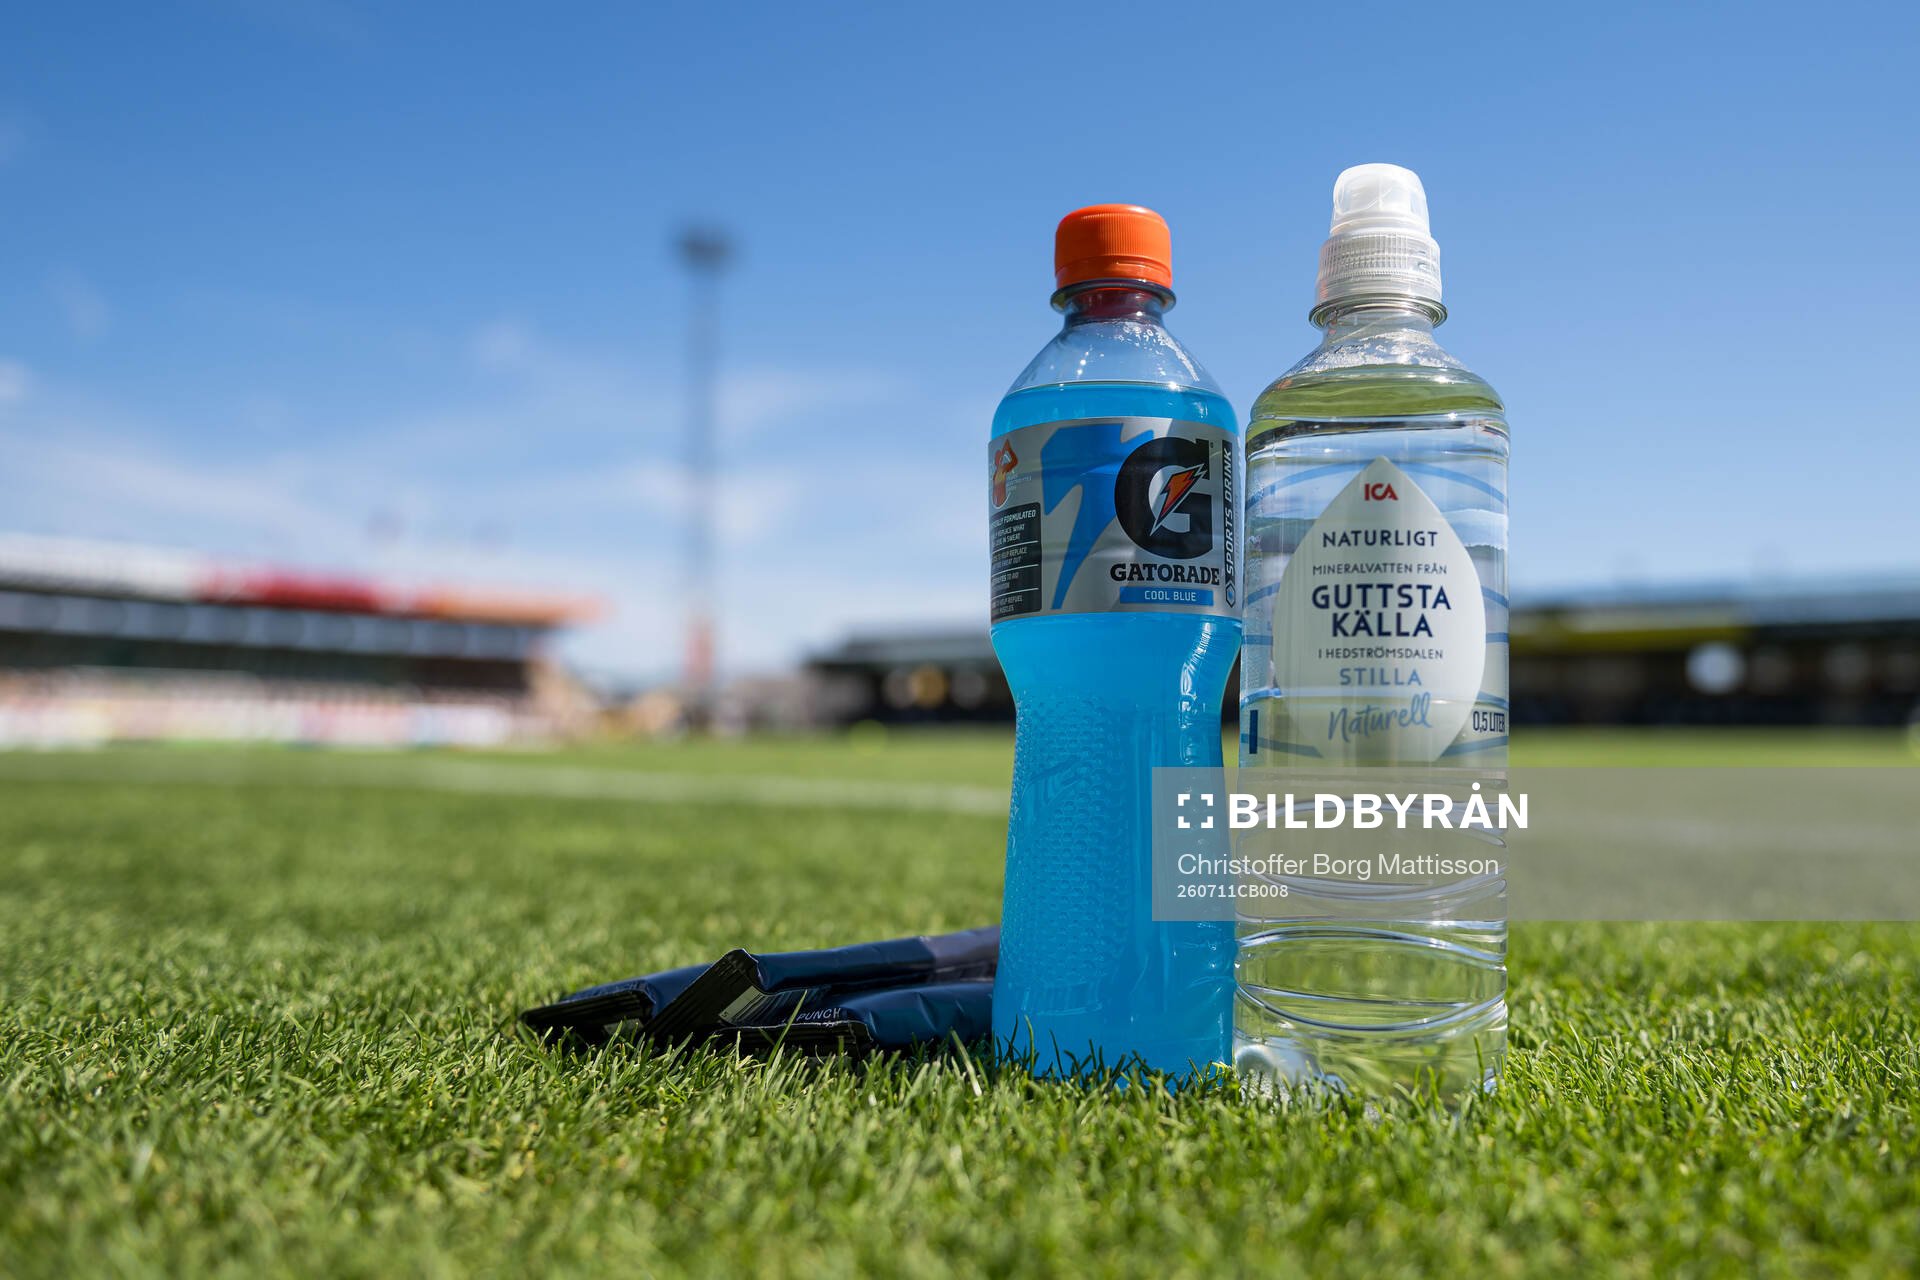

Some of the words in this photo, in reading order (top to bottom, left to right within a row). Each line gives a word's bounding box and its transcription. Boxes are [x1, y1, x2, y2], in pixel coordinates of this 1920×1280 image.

[1223, 447, 1232, 503] DRINK
[1364, 483, 1398, 501] ICA
[1004, 509, 1037, 523] FORMULATED
[1225, 507, 1233, 577] SPORTS
[1322, 530, 1438, 548] NATURLIGT
[1110, 563, 1220, 586] GATORADE
[1312, 563, 1413, 576] MINERALVATTEN
[1416, 562, 1448, 575] FRÅN
[1144, 590, 1170, 600] COOL
[1173, 591, 1197, 602] BLUE
[1312, 584, 1452, 610] GUTTSTA
[1332, 610, 1434, 638] KÄLLA
[1318, 649, 1322, 659] I
[1326, 646, 1444, 660] HEDSTRÖMSDALEN
[1339, 668, 1422, 687] STILLA
[1328, 692, 1433, 743] Naturell
[1473, 711, 1488, 733] 0,5
[796, 1007, 841, 1022] PUNCH
